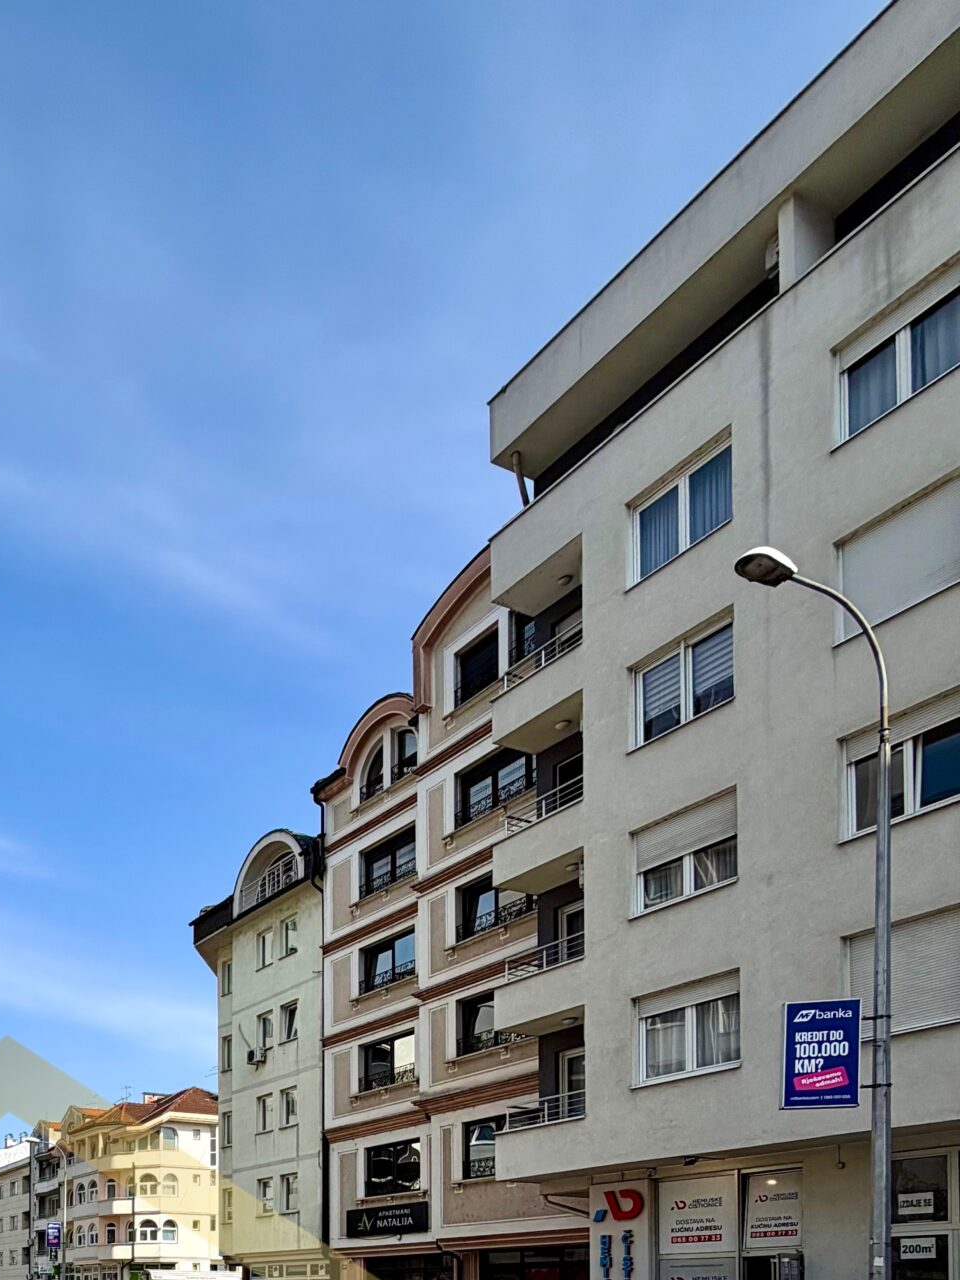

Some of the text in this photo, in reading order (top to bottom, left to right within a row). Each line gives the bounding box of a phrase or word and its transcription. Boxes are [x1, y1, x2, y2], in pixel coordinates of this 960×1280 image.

[816, 1008, 853, 1019] banka
[795, 1030, 844, 1042] KREDIT DO
[795, 1041, 849, 1058] 100.000
[795, 1059, 824, 1073] KM?
[378, 1208, 411, 1217] APARTMANI
[376, 1217, 414, 1228] NATALIJA
